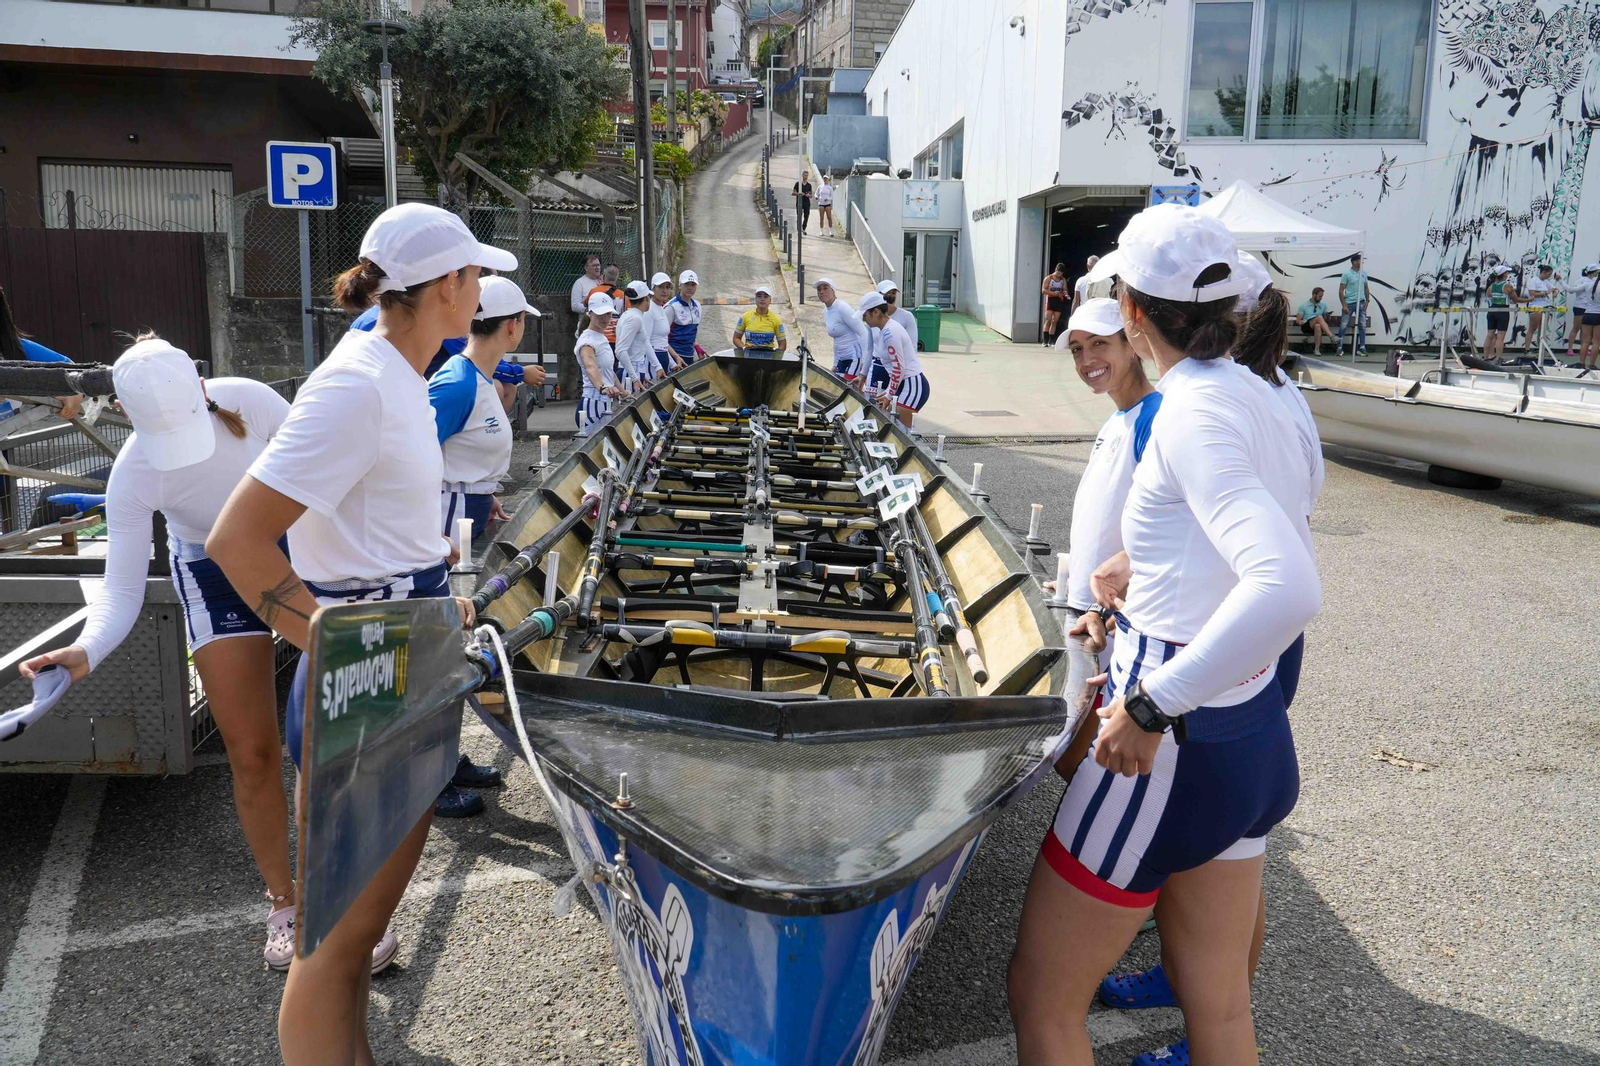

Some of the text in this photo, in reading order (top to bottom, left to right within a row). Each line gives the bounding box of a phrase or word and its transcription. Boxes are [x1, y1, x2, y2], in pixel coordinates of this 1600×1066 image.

[281, 152, 324, 199] P
[887, 345, 903, 396] PERILLO
[361, 621, 385, 651] Perillo
[322, 649, 395, 721] McDonald's
